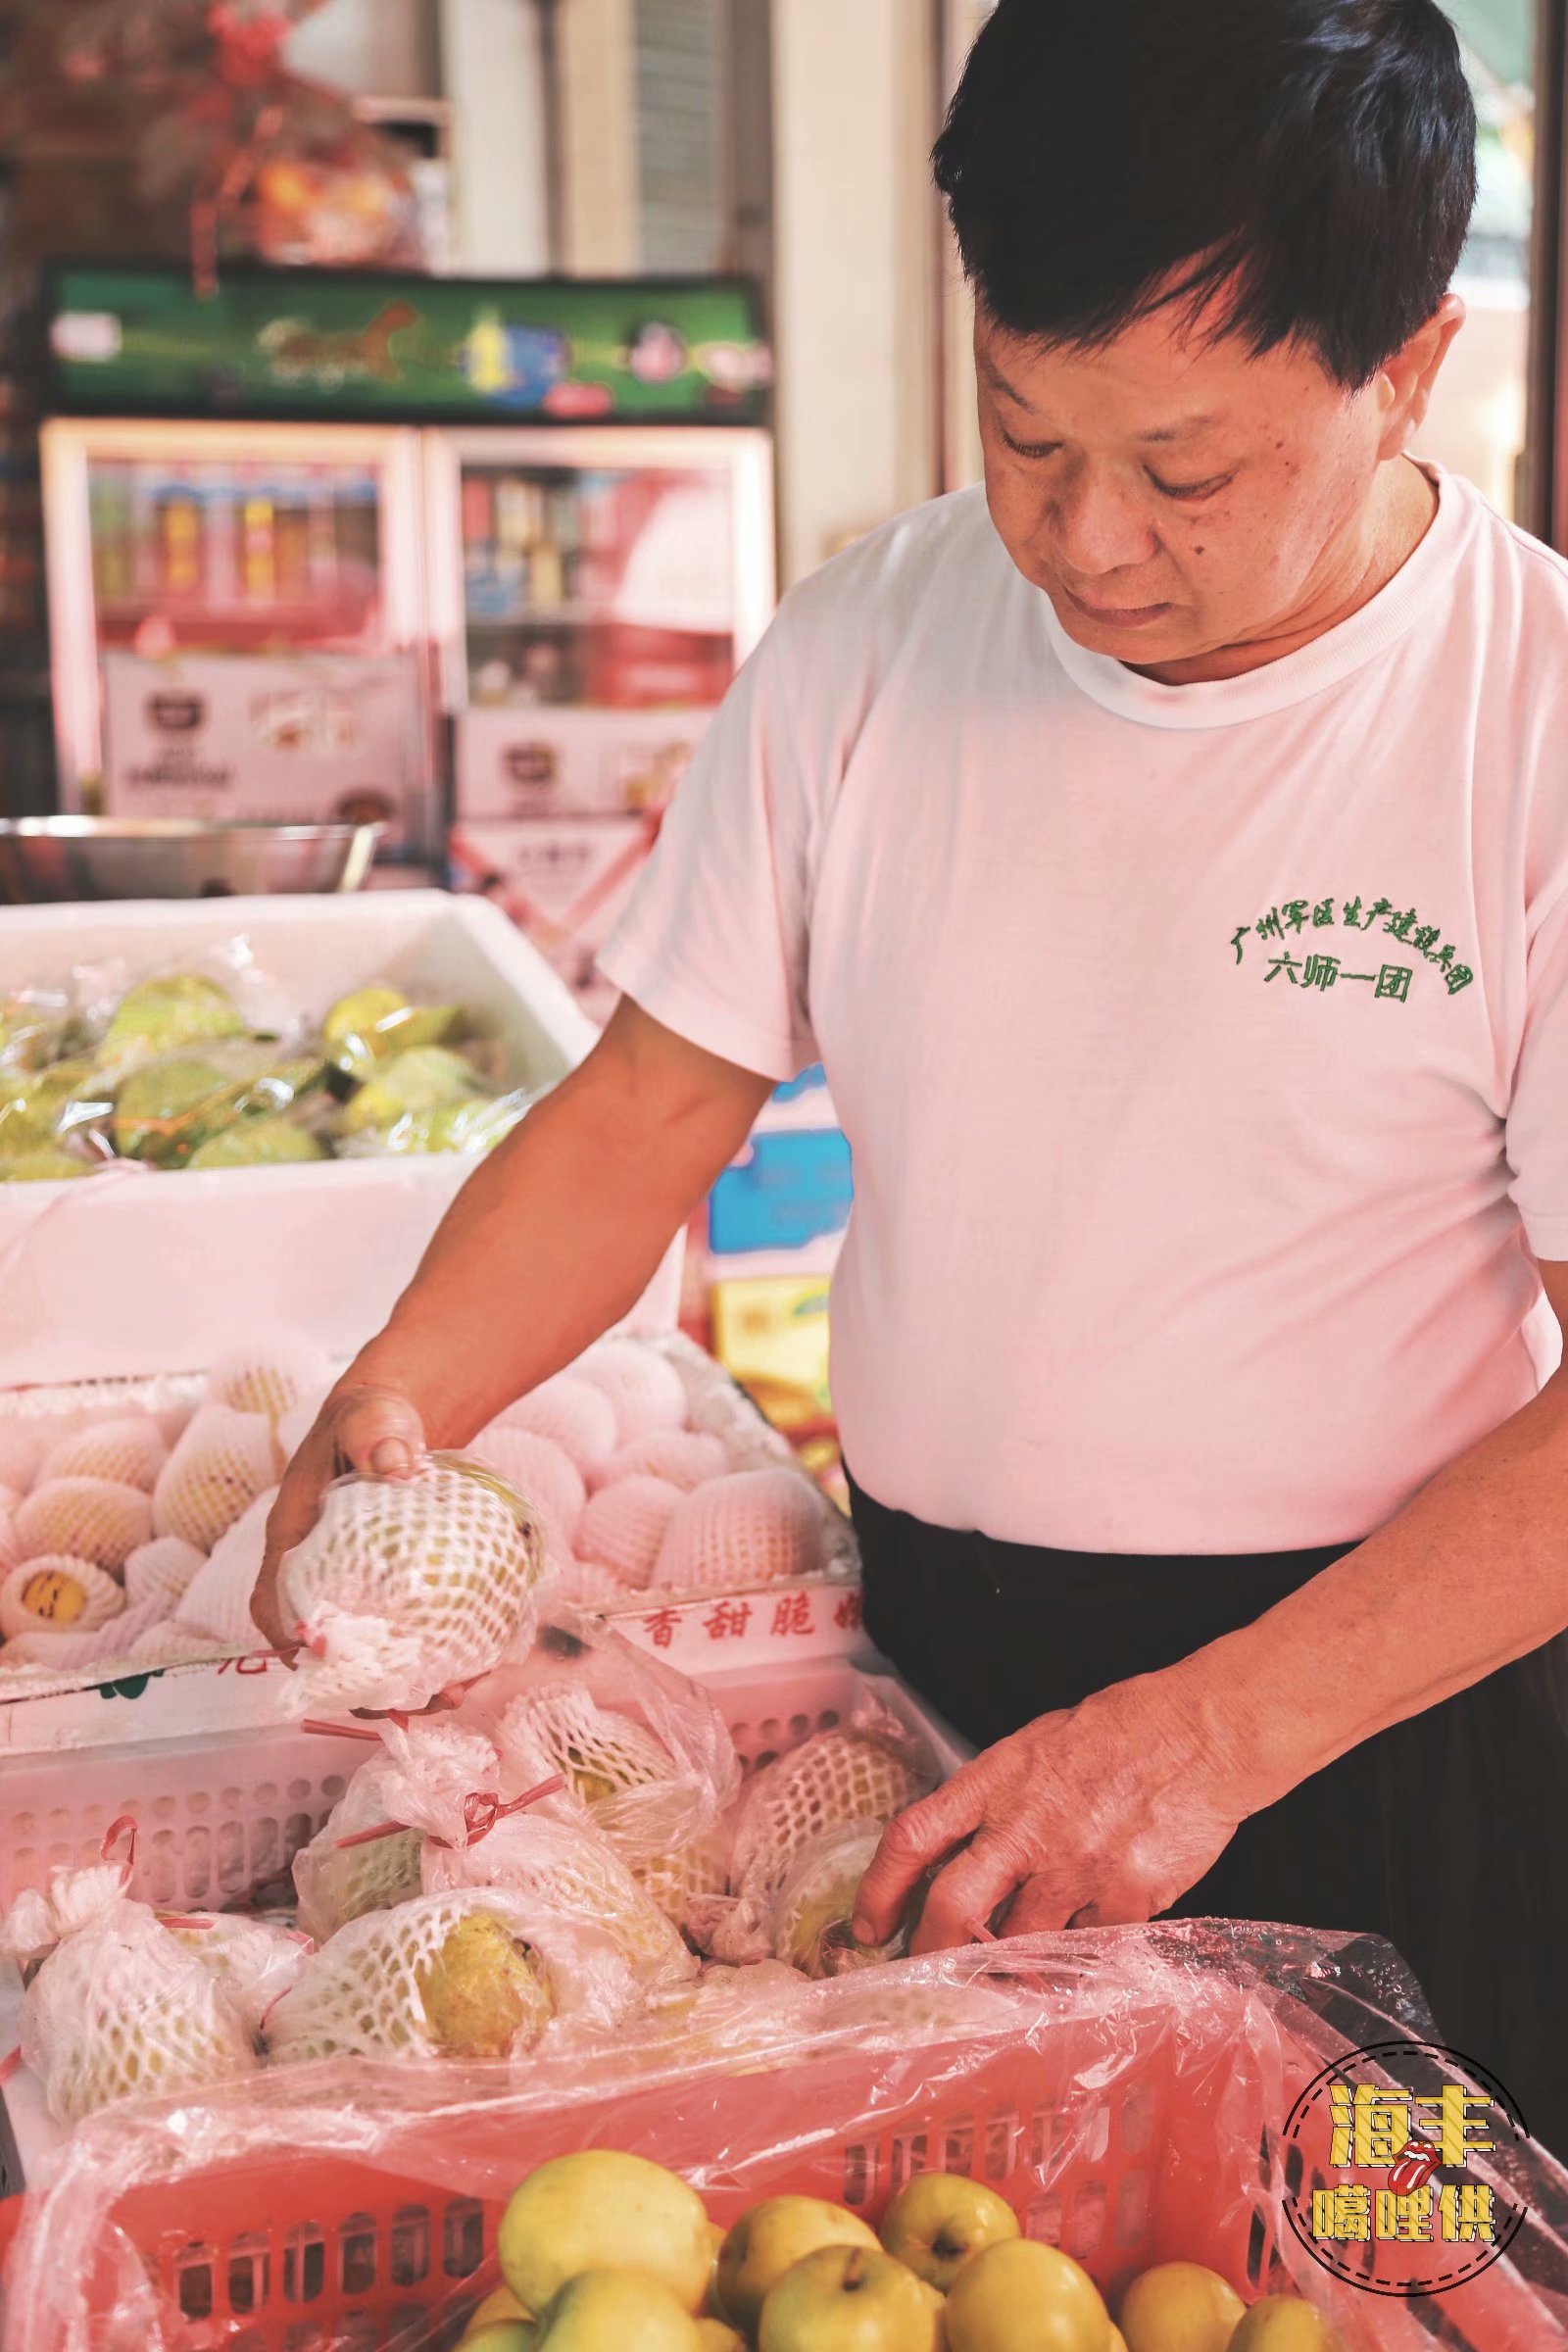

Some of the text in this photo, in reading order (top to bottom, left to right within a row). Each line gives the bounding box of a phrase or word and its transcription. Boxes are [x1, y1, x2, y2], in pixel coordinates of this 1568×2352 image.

[1231, 896, 1474, 995] 广州军区生产建设兵团
[1264, 952, 1413, 1003] 六师一团
